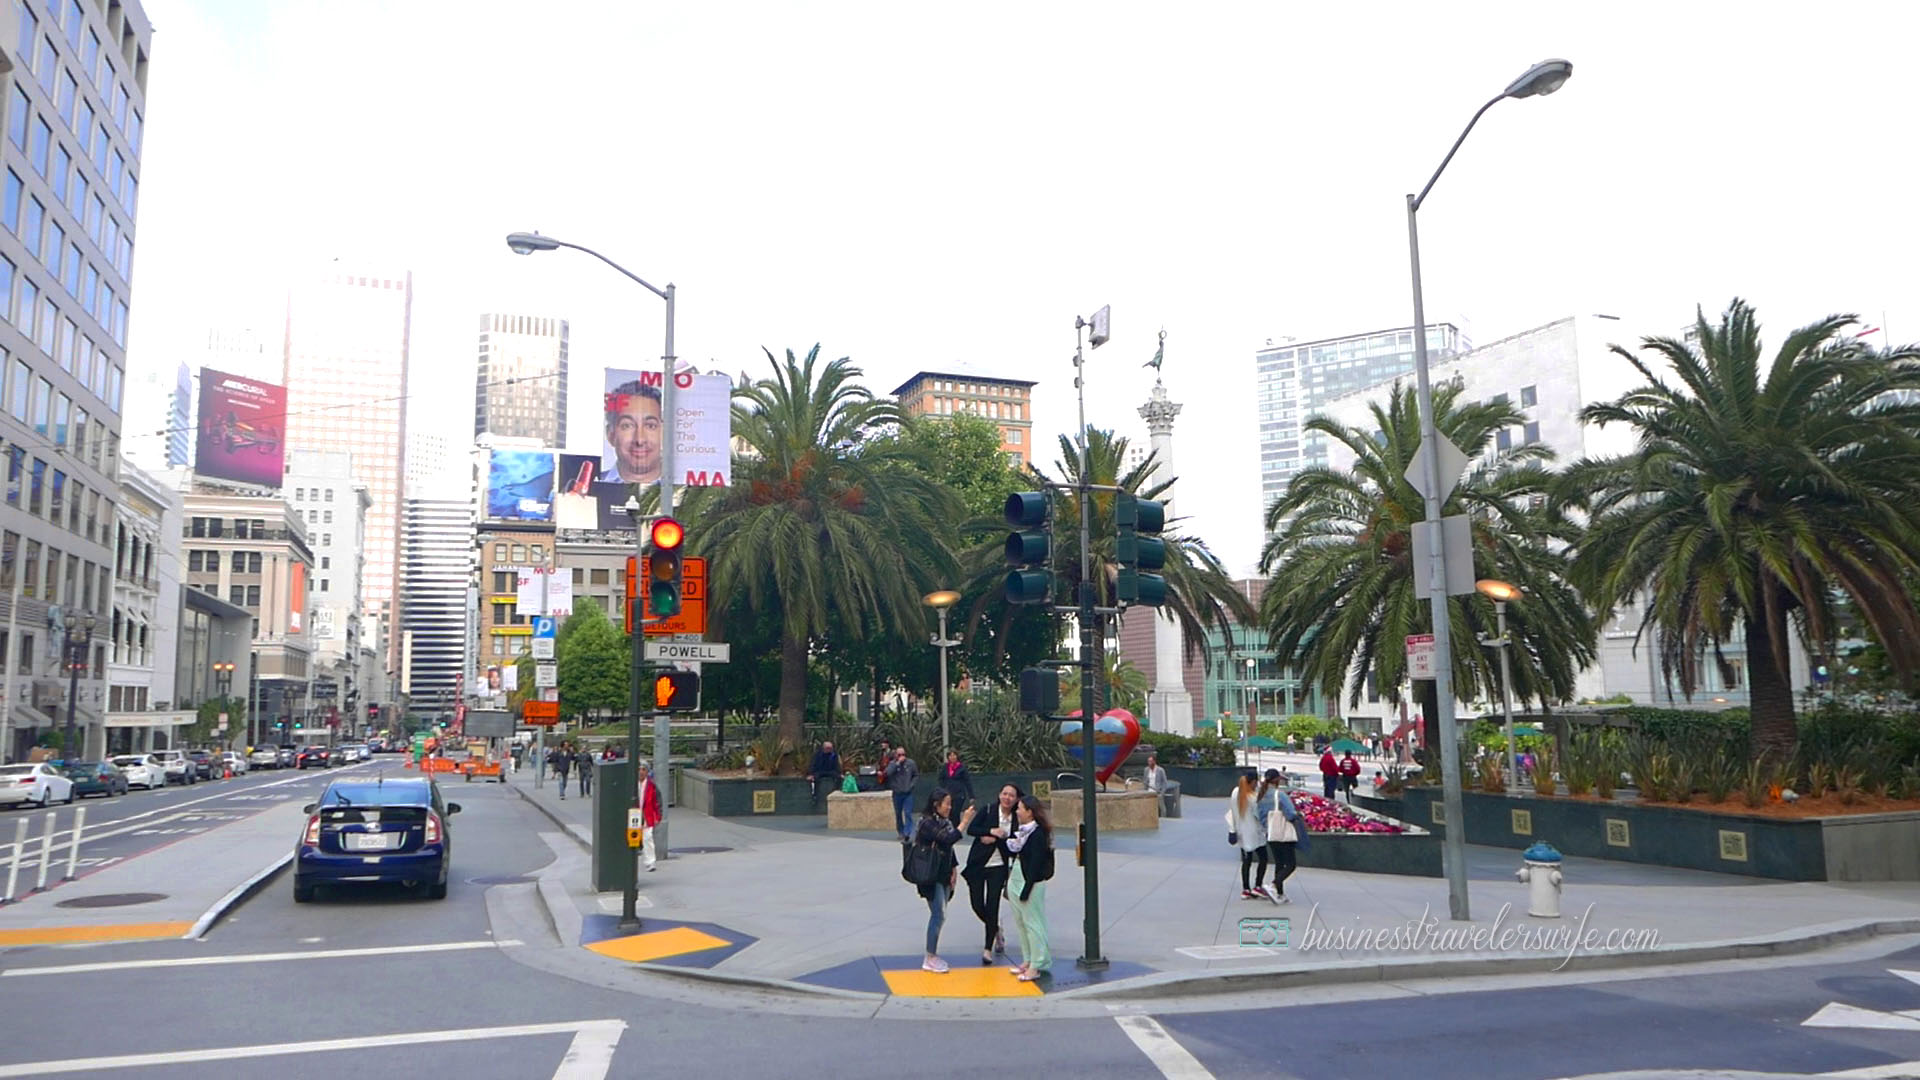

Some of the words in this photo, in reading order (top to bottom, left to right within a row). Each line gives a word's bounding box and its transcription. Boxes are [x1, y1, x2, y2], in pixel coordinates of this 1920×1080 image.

[676, 408, 705, 418] Open
[676, 420, 696, 429] For
[676, 431, 696, 441] The
[676, 444, 717, 454] Curious
[659, 646, 717, 659] POWELL
